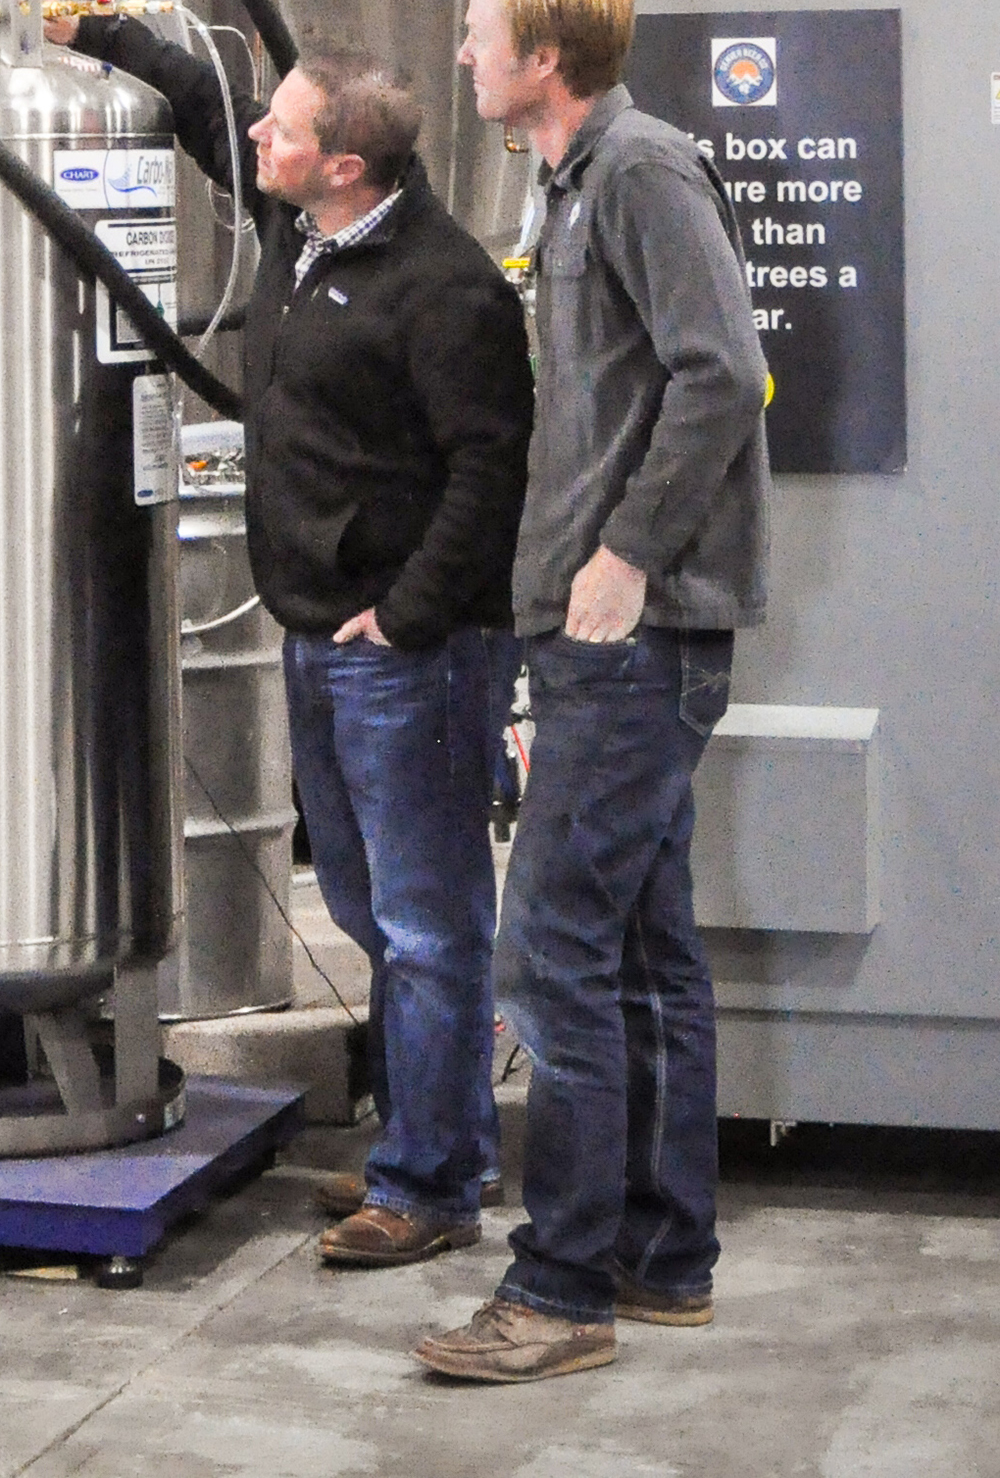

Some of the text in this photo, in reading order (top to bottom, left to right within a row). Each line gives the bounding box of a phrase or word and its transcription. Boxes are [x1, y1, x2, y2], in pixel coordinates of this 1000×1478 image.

[726, 133, 787, 160] box
[798, 137, 857, 160] can
[62, 171, 95, 180] CHART
[777, 180, 863, 202] more
[126, 231, 157, 246] CARBON
[752, 217, 825, 245] than
[745, 261, 857, 288] trees a
